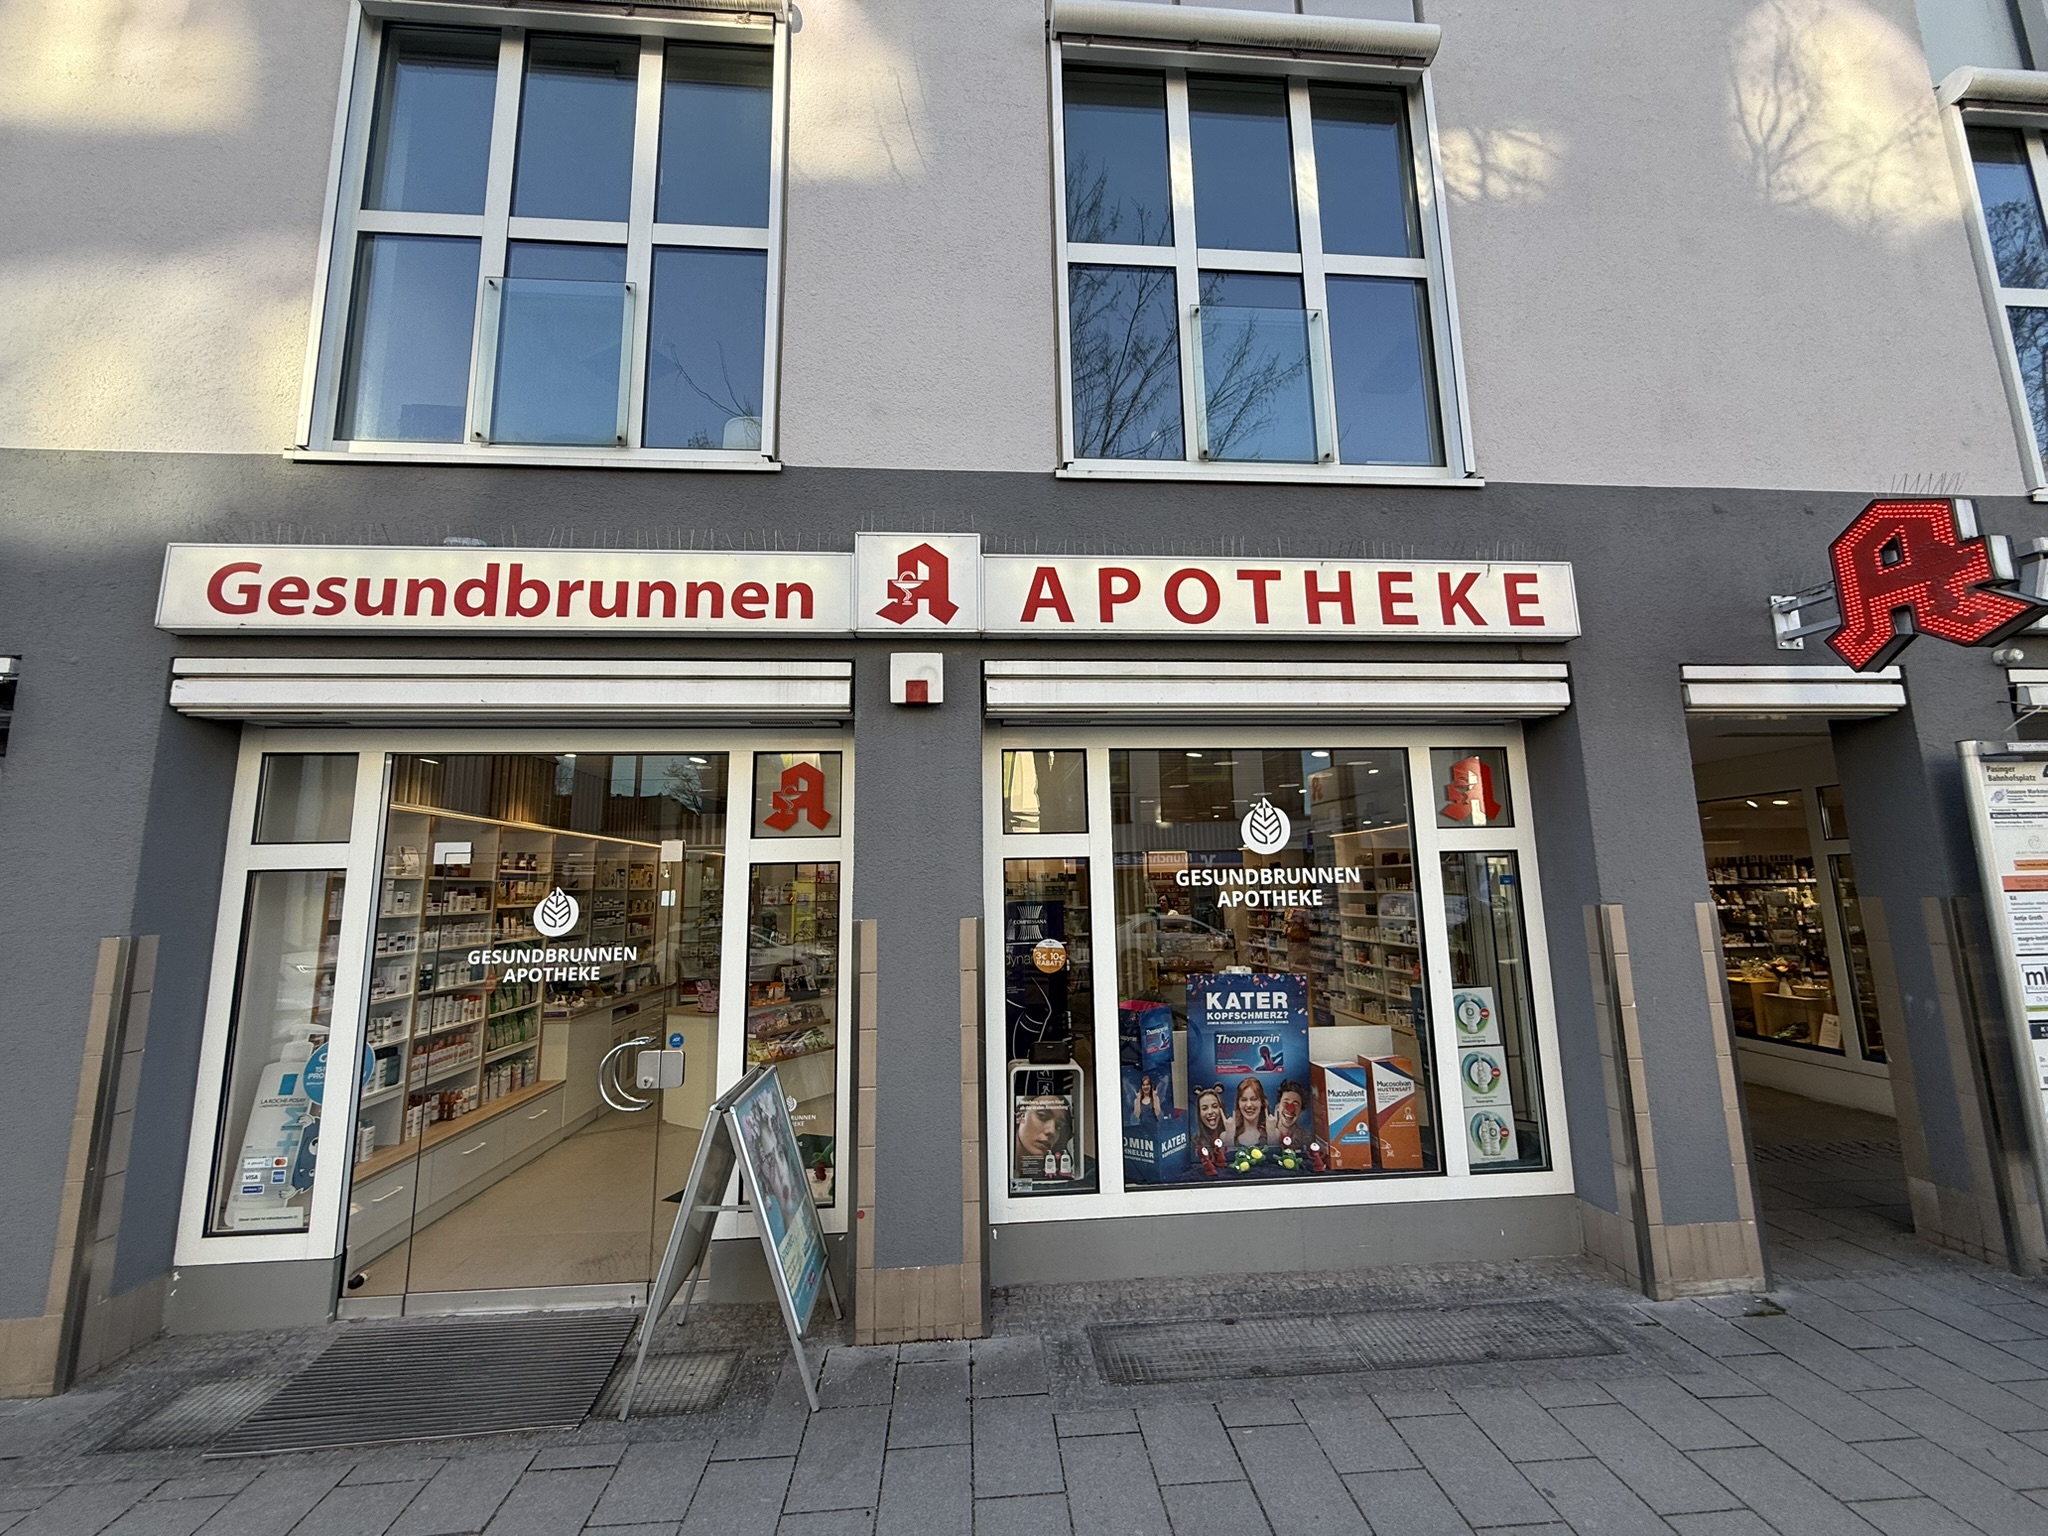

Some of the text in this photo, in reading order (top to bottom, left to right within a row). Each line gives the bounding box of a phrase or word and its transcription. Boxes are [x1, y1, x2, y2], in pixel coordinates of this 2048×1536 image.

[207, 562, 814, 619] Gesundbrunnen
[1021, 566, 1545, 627] APOTHEKE
[1986, 765, 2016, 775] Pasinger
[1987, 774, 2037, 783] Bahnhofsplatz
[1175, 866, 1361, 887] GESUNDBRUNNEN
[1217, 889, 1323, 908] APOTHEKE
[467, 946, 638, 965] GESUNDBRUNNEN
[502, 966, 601, 983] APOTHEKE
[1206, 991, 1289, 1010] KATER
[1206, 1011, 1289, 1020] KOPFSCHMERZ?
[1216, 1033, 1280, 1045] Thomapyrin
[1376, 1080, 1412, 1088] Mucosolvan
[1327, 1089, 1365, 1097] Mucosilent
[1161, 1132, 1187, 1153] KATER
